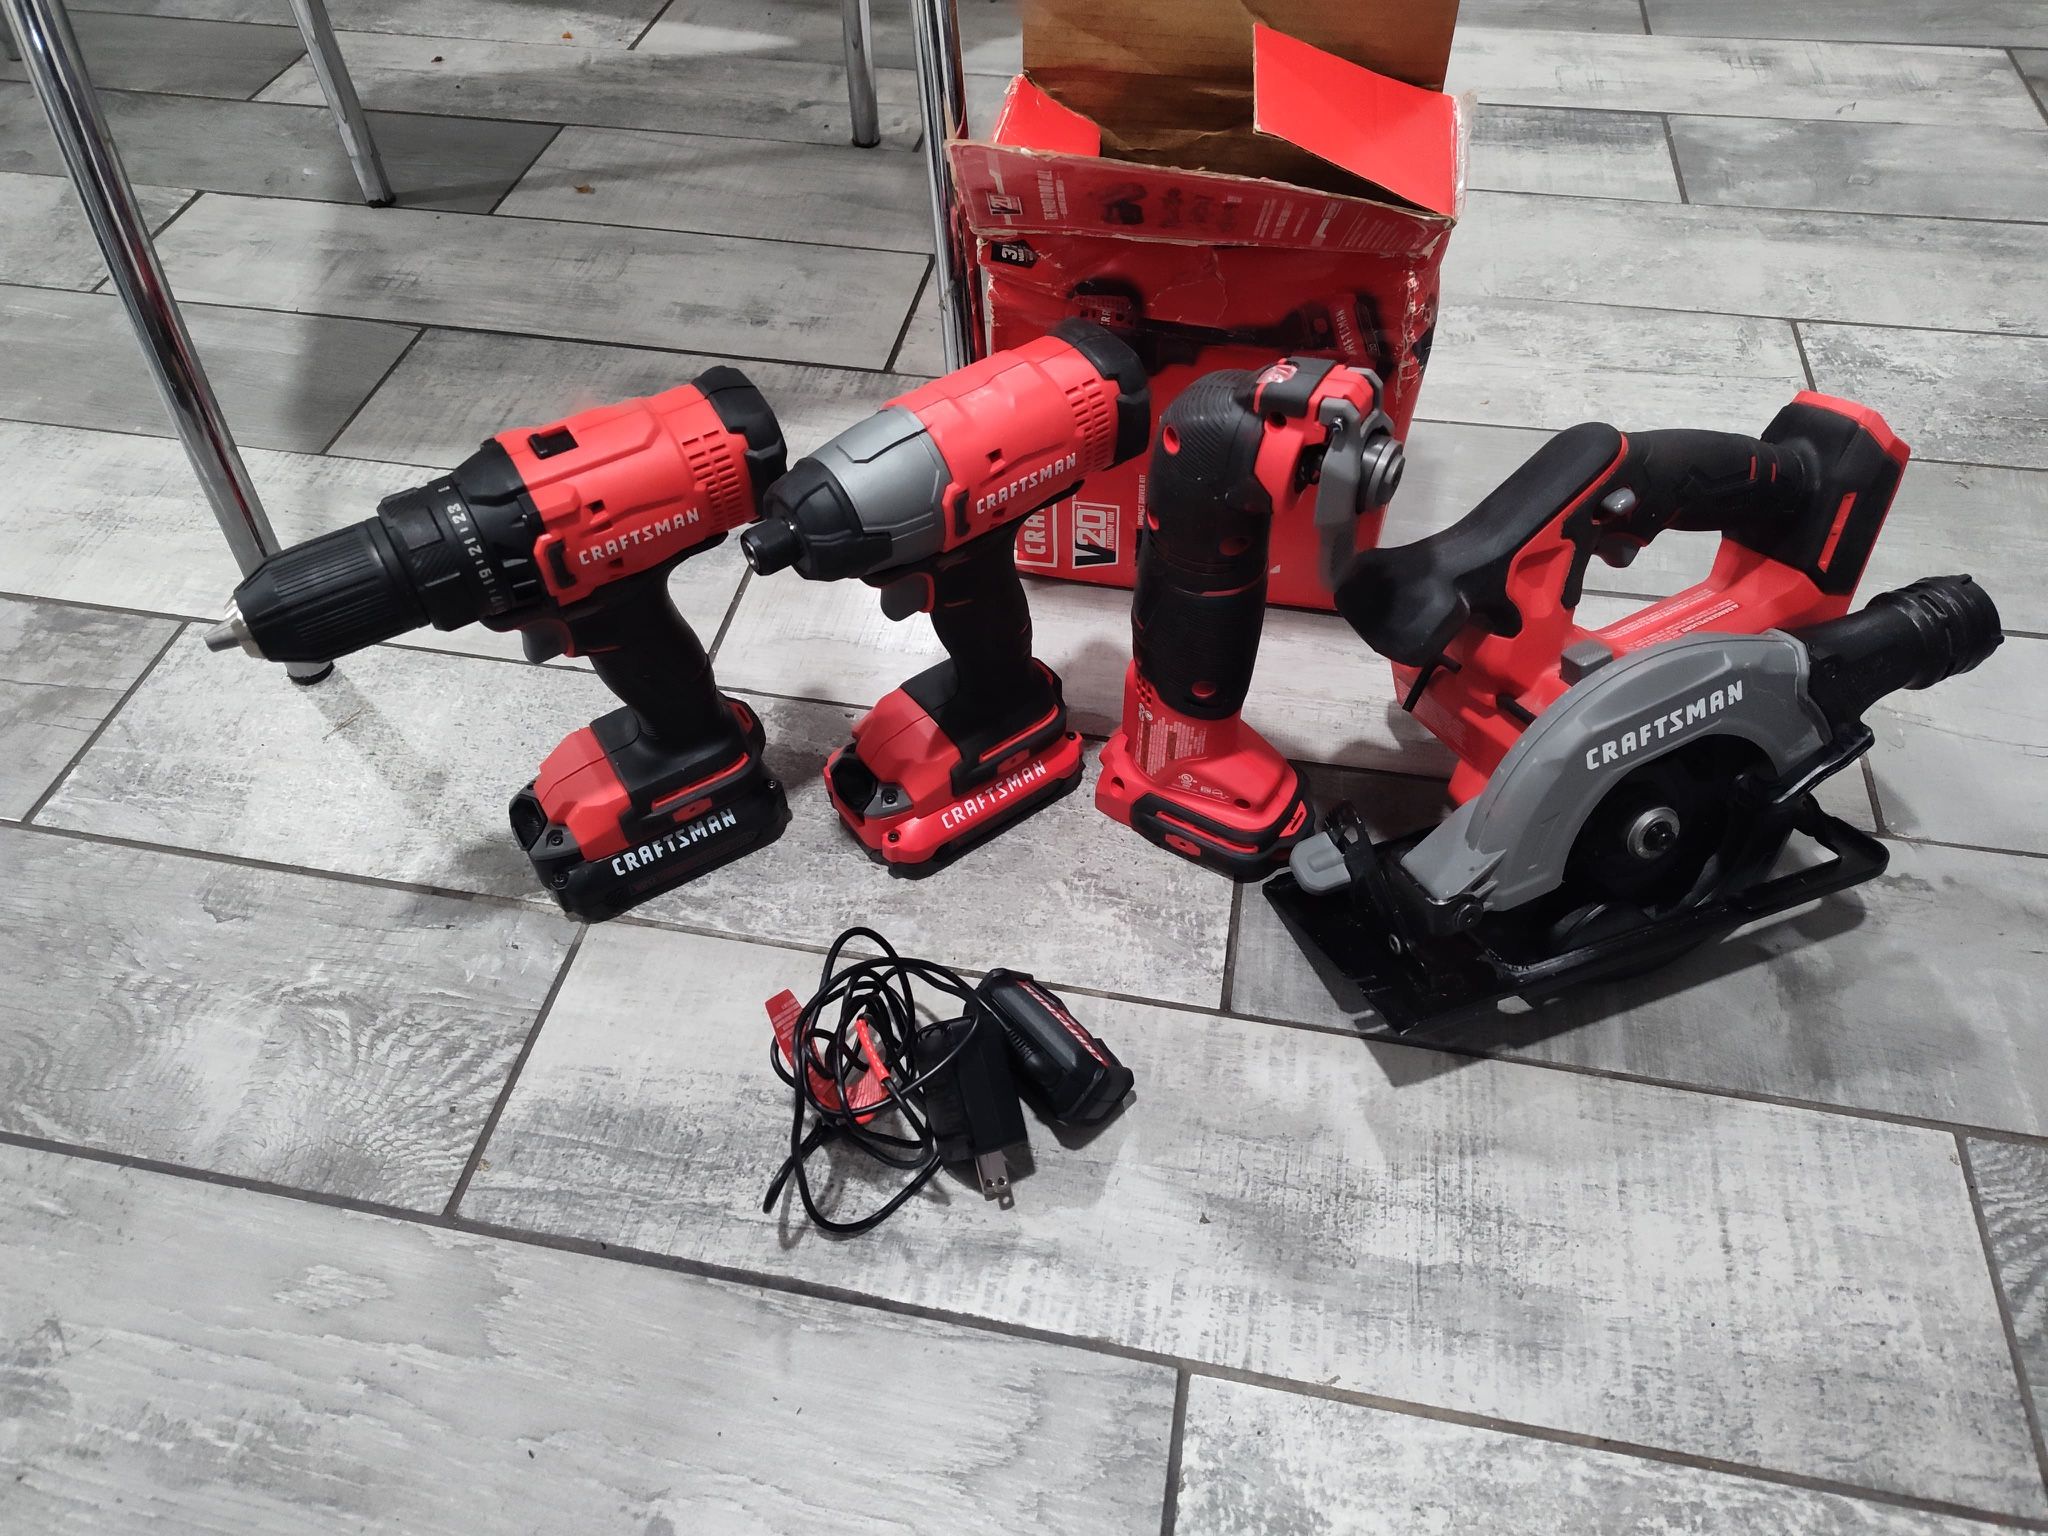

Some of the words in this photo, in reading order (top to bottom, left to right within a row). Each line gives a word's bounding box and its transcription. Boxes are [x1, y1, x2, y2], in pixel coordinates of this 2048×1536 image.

[976, 452, 1076, 514] CRAFTSMAN
[446, 502, 468, 525] 23
[578, 507, 700, 566] CRAFTSMAN
[1023, 508, 1047, 555] CRA
[1074, 508, 1116, 567] V20
[1106, 524, 1115, 550] LITHIUM
[1107, 511, 1115, 523] ION
[463, 537, 483, 557] 21
[478, 567, 496, 585] 19
[1585, 679, 1743, 771] CRAFTSMAN
[941, 759, 1046, 829] CRAFTSMAN
[611, 808, 737, 876] CRAFTSMAN
